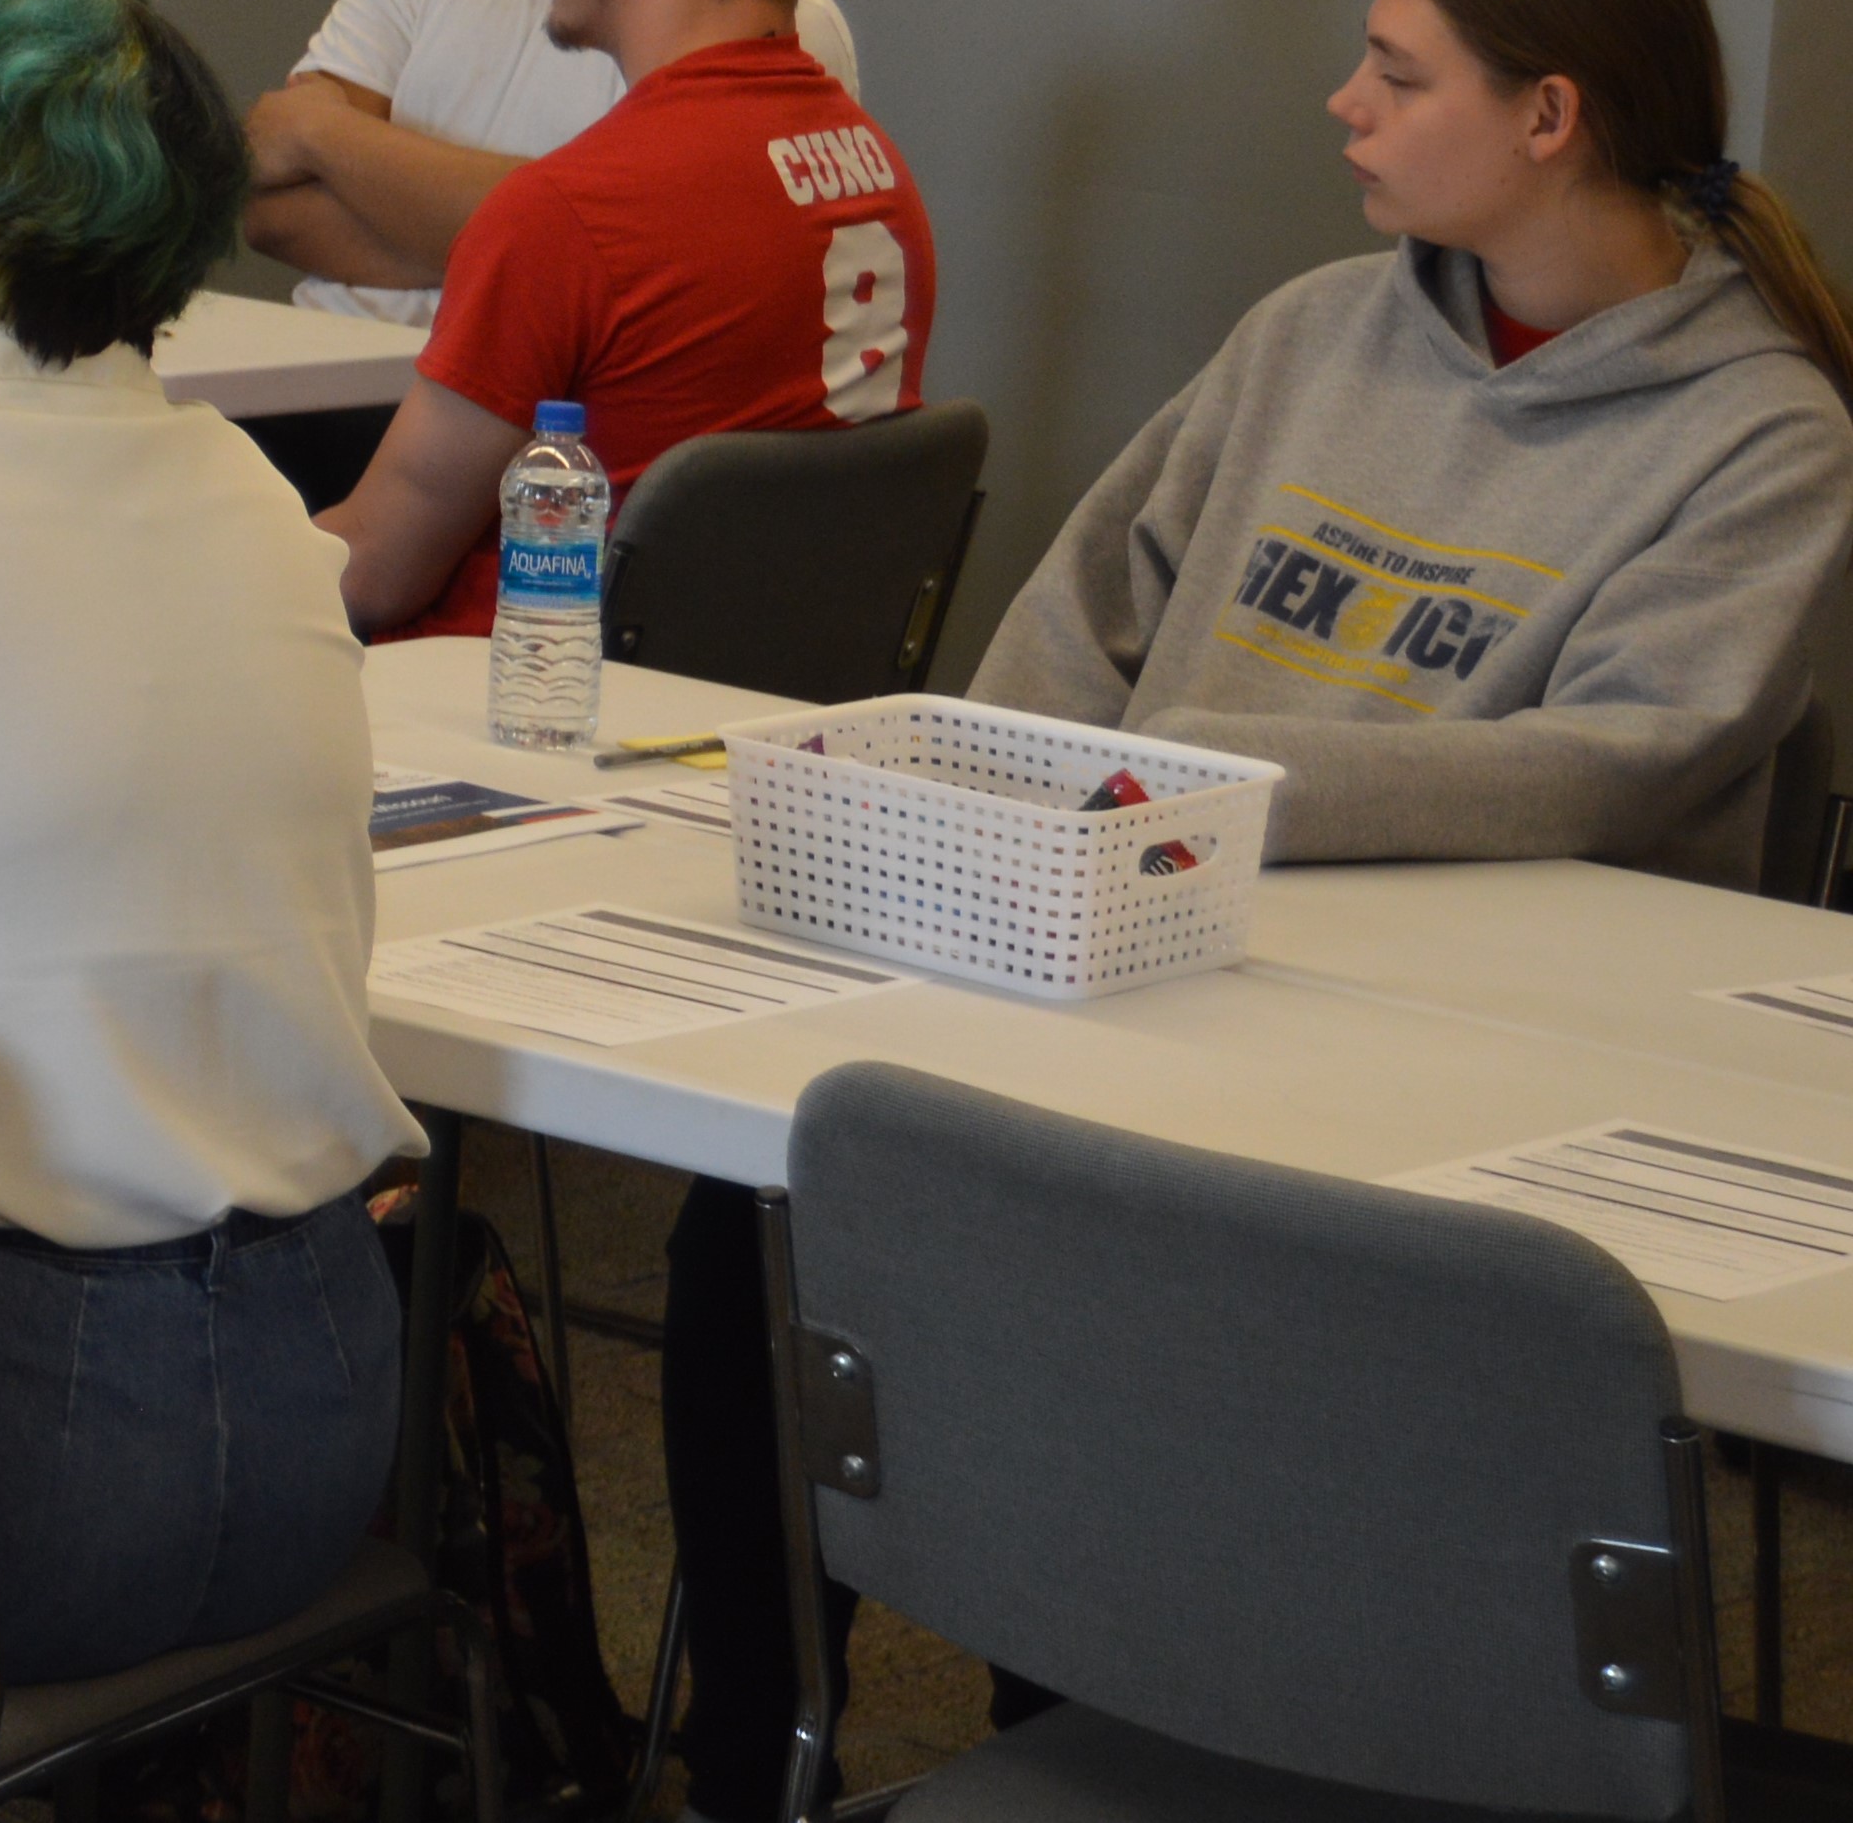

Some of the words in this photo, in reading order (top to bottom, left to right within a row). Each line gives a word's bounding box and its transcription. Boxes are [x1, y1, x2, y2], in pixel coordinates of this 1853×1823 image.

[767, 125, 895, 207] CUNO
[821, 220, 909, 424] 8
[508, 549, 591, 579] AQUAFINA
[1313, 522, 1379, 563] ASPIRE
[1381, 549, 1409, 575] TO
[1406, 559, 1477, 586] INSPIRE
